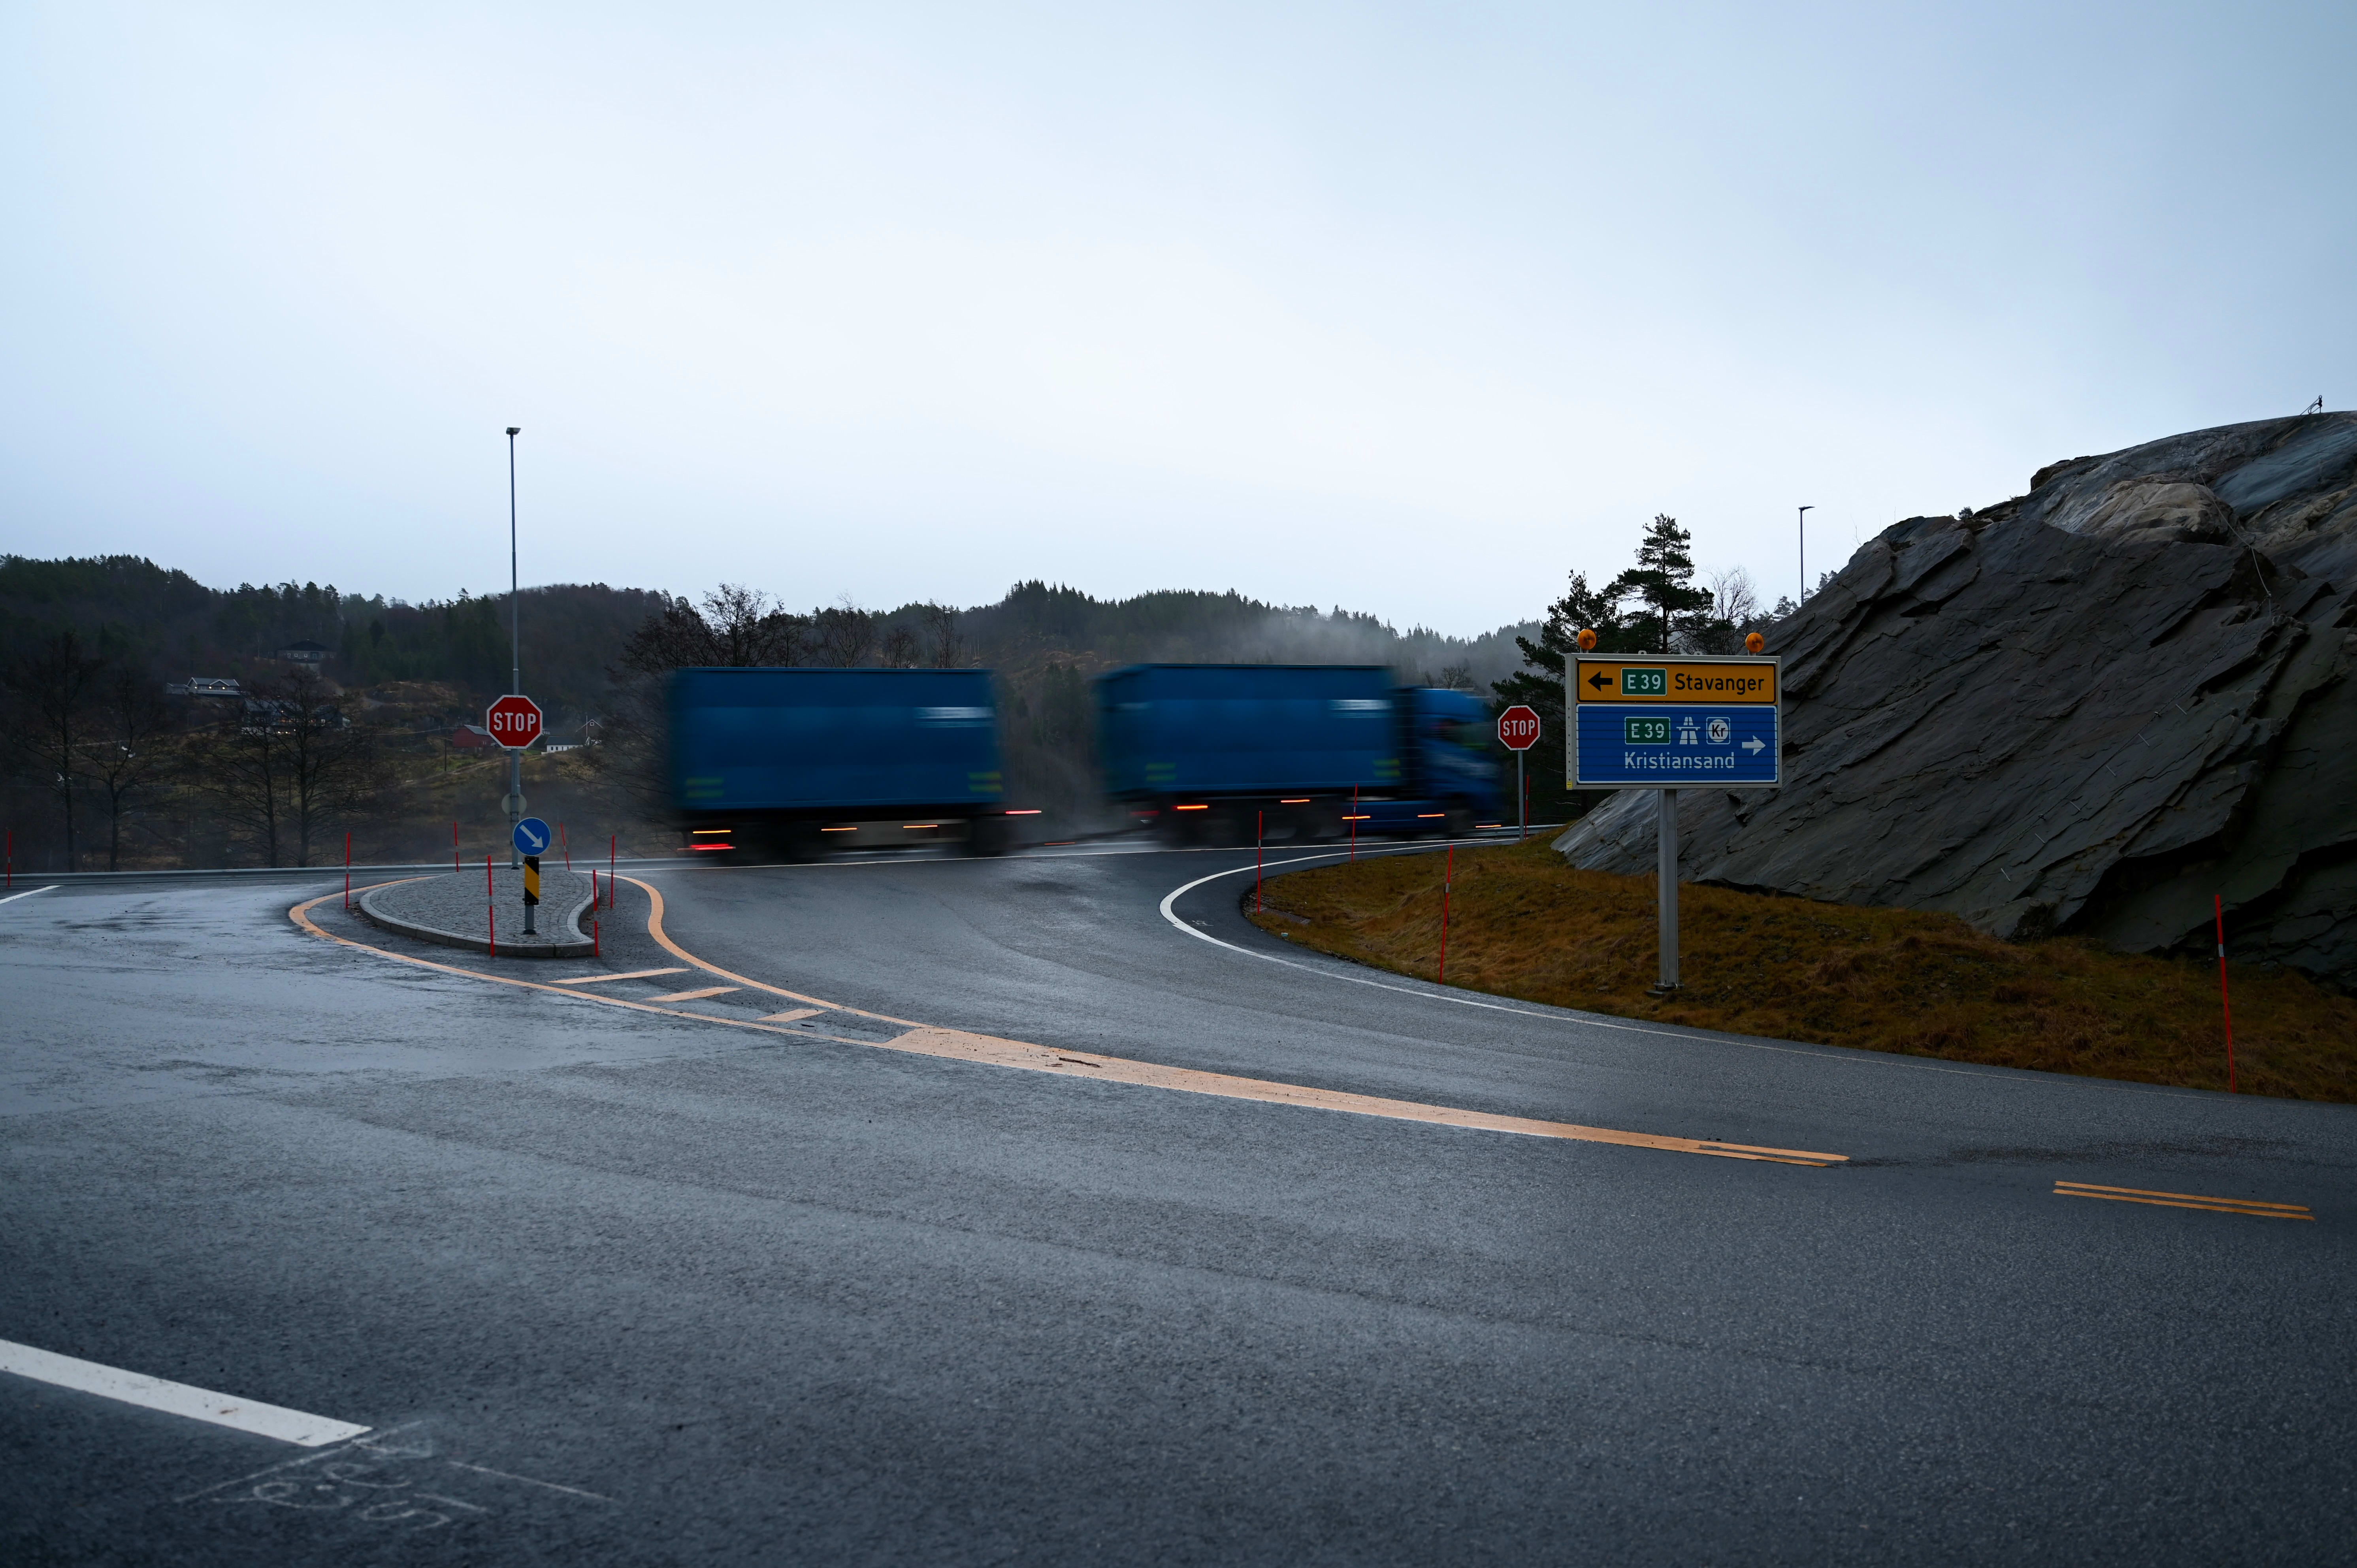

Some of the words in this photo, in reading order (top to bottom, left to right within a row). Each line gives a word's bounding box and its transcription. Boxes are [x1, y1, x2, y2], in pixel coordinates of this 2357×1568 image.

[1628, 674, 1636, 689] E
[1641, 674, 1661, 689] 39
[1675, 673, 1764, 695] Stavanger
[494, 712, 536, 731] STOP
[1503, 720, 1536, 736] STOP
[1631, 723, 1640, 738] E
[1645, 723, 1665, 738] 39
[1712, 724, 1726, 737] Kr
[1625, 752, 1735, 769] Kristiansand
